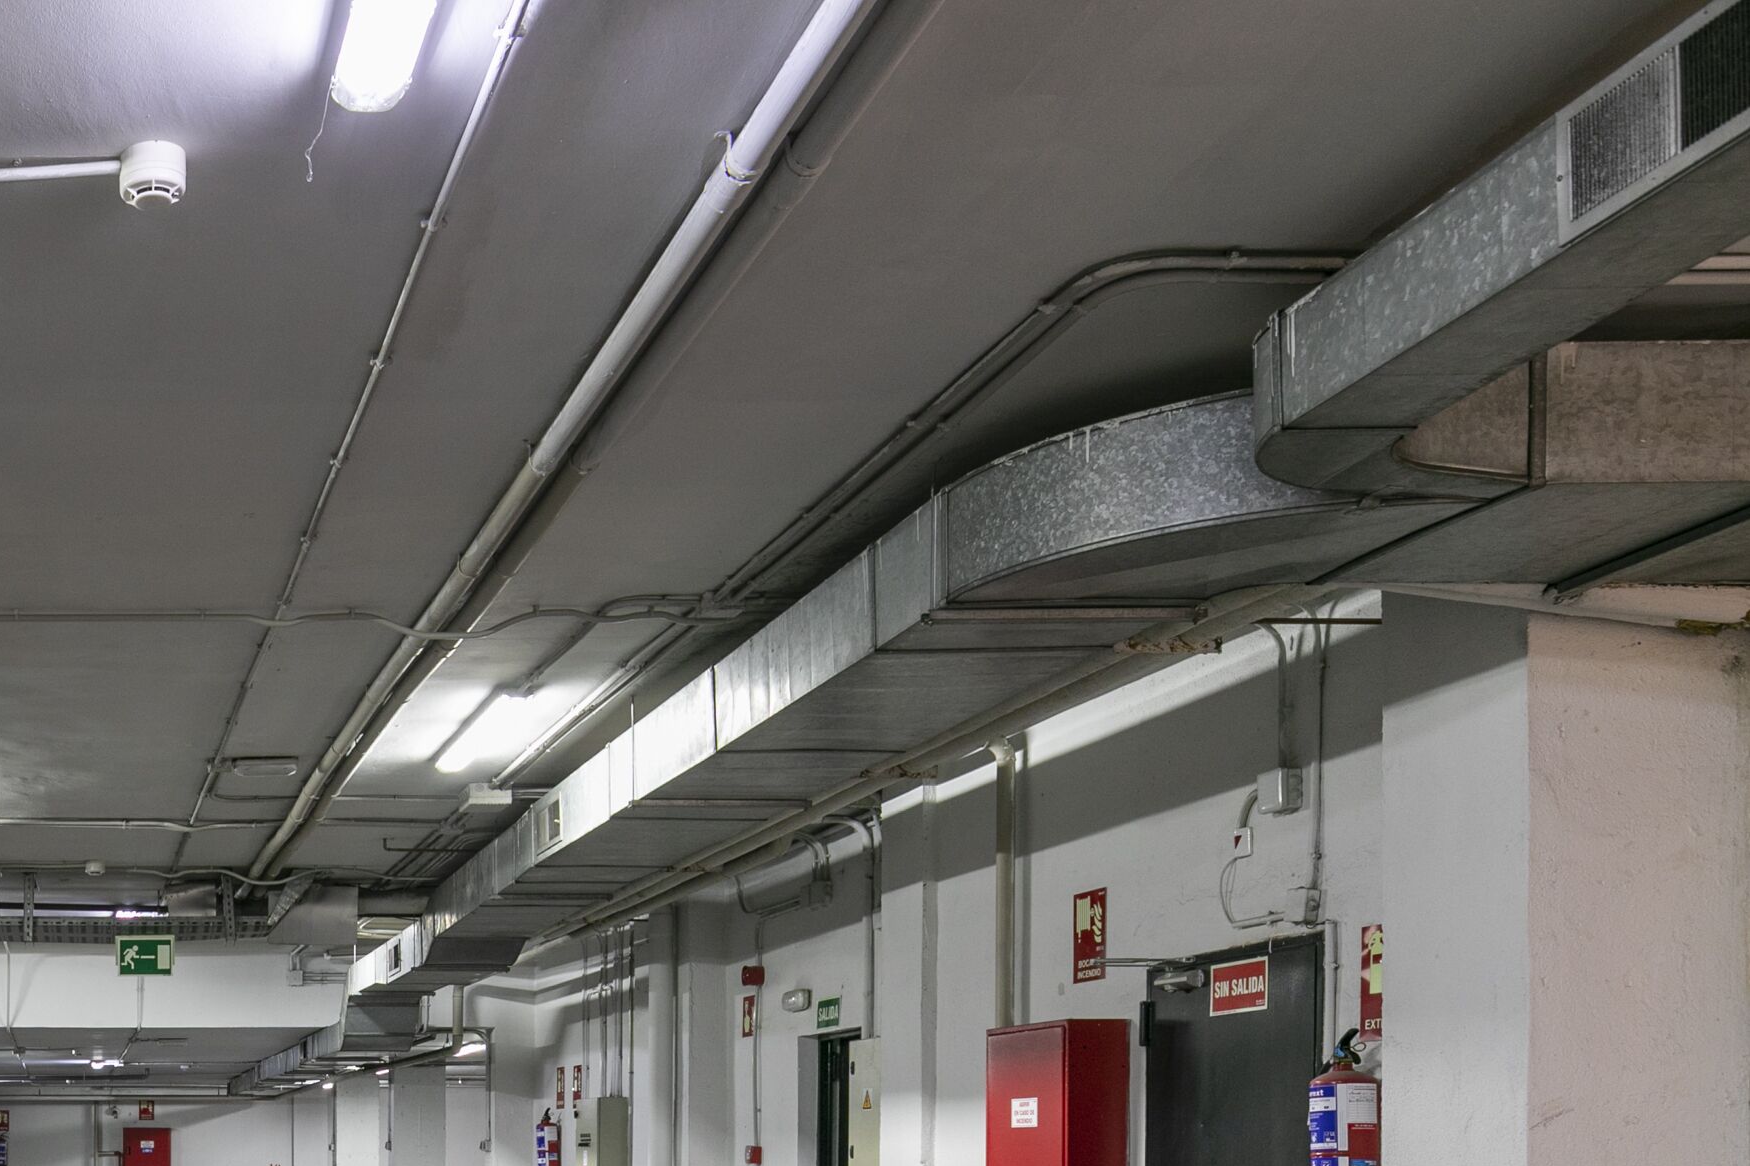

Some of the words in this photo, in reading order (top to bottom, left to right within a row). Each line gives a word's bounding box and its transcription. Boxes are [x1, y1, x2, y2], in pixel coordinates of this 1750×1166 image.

[1077, 968, 1101, 979] INCENDIO
[1214, 980, 1230, 998] SIN
[1231, 975, 1264, 996] SALIDA
[818, 1004, 839, 1021] SALIDA
